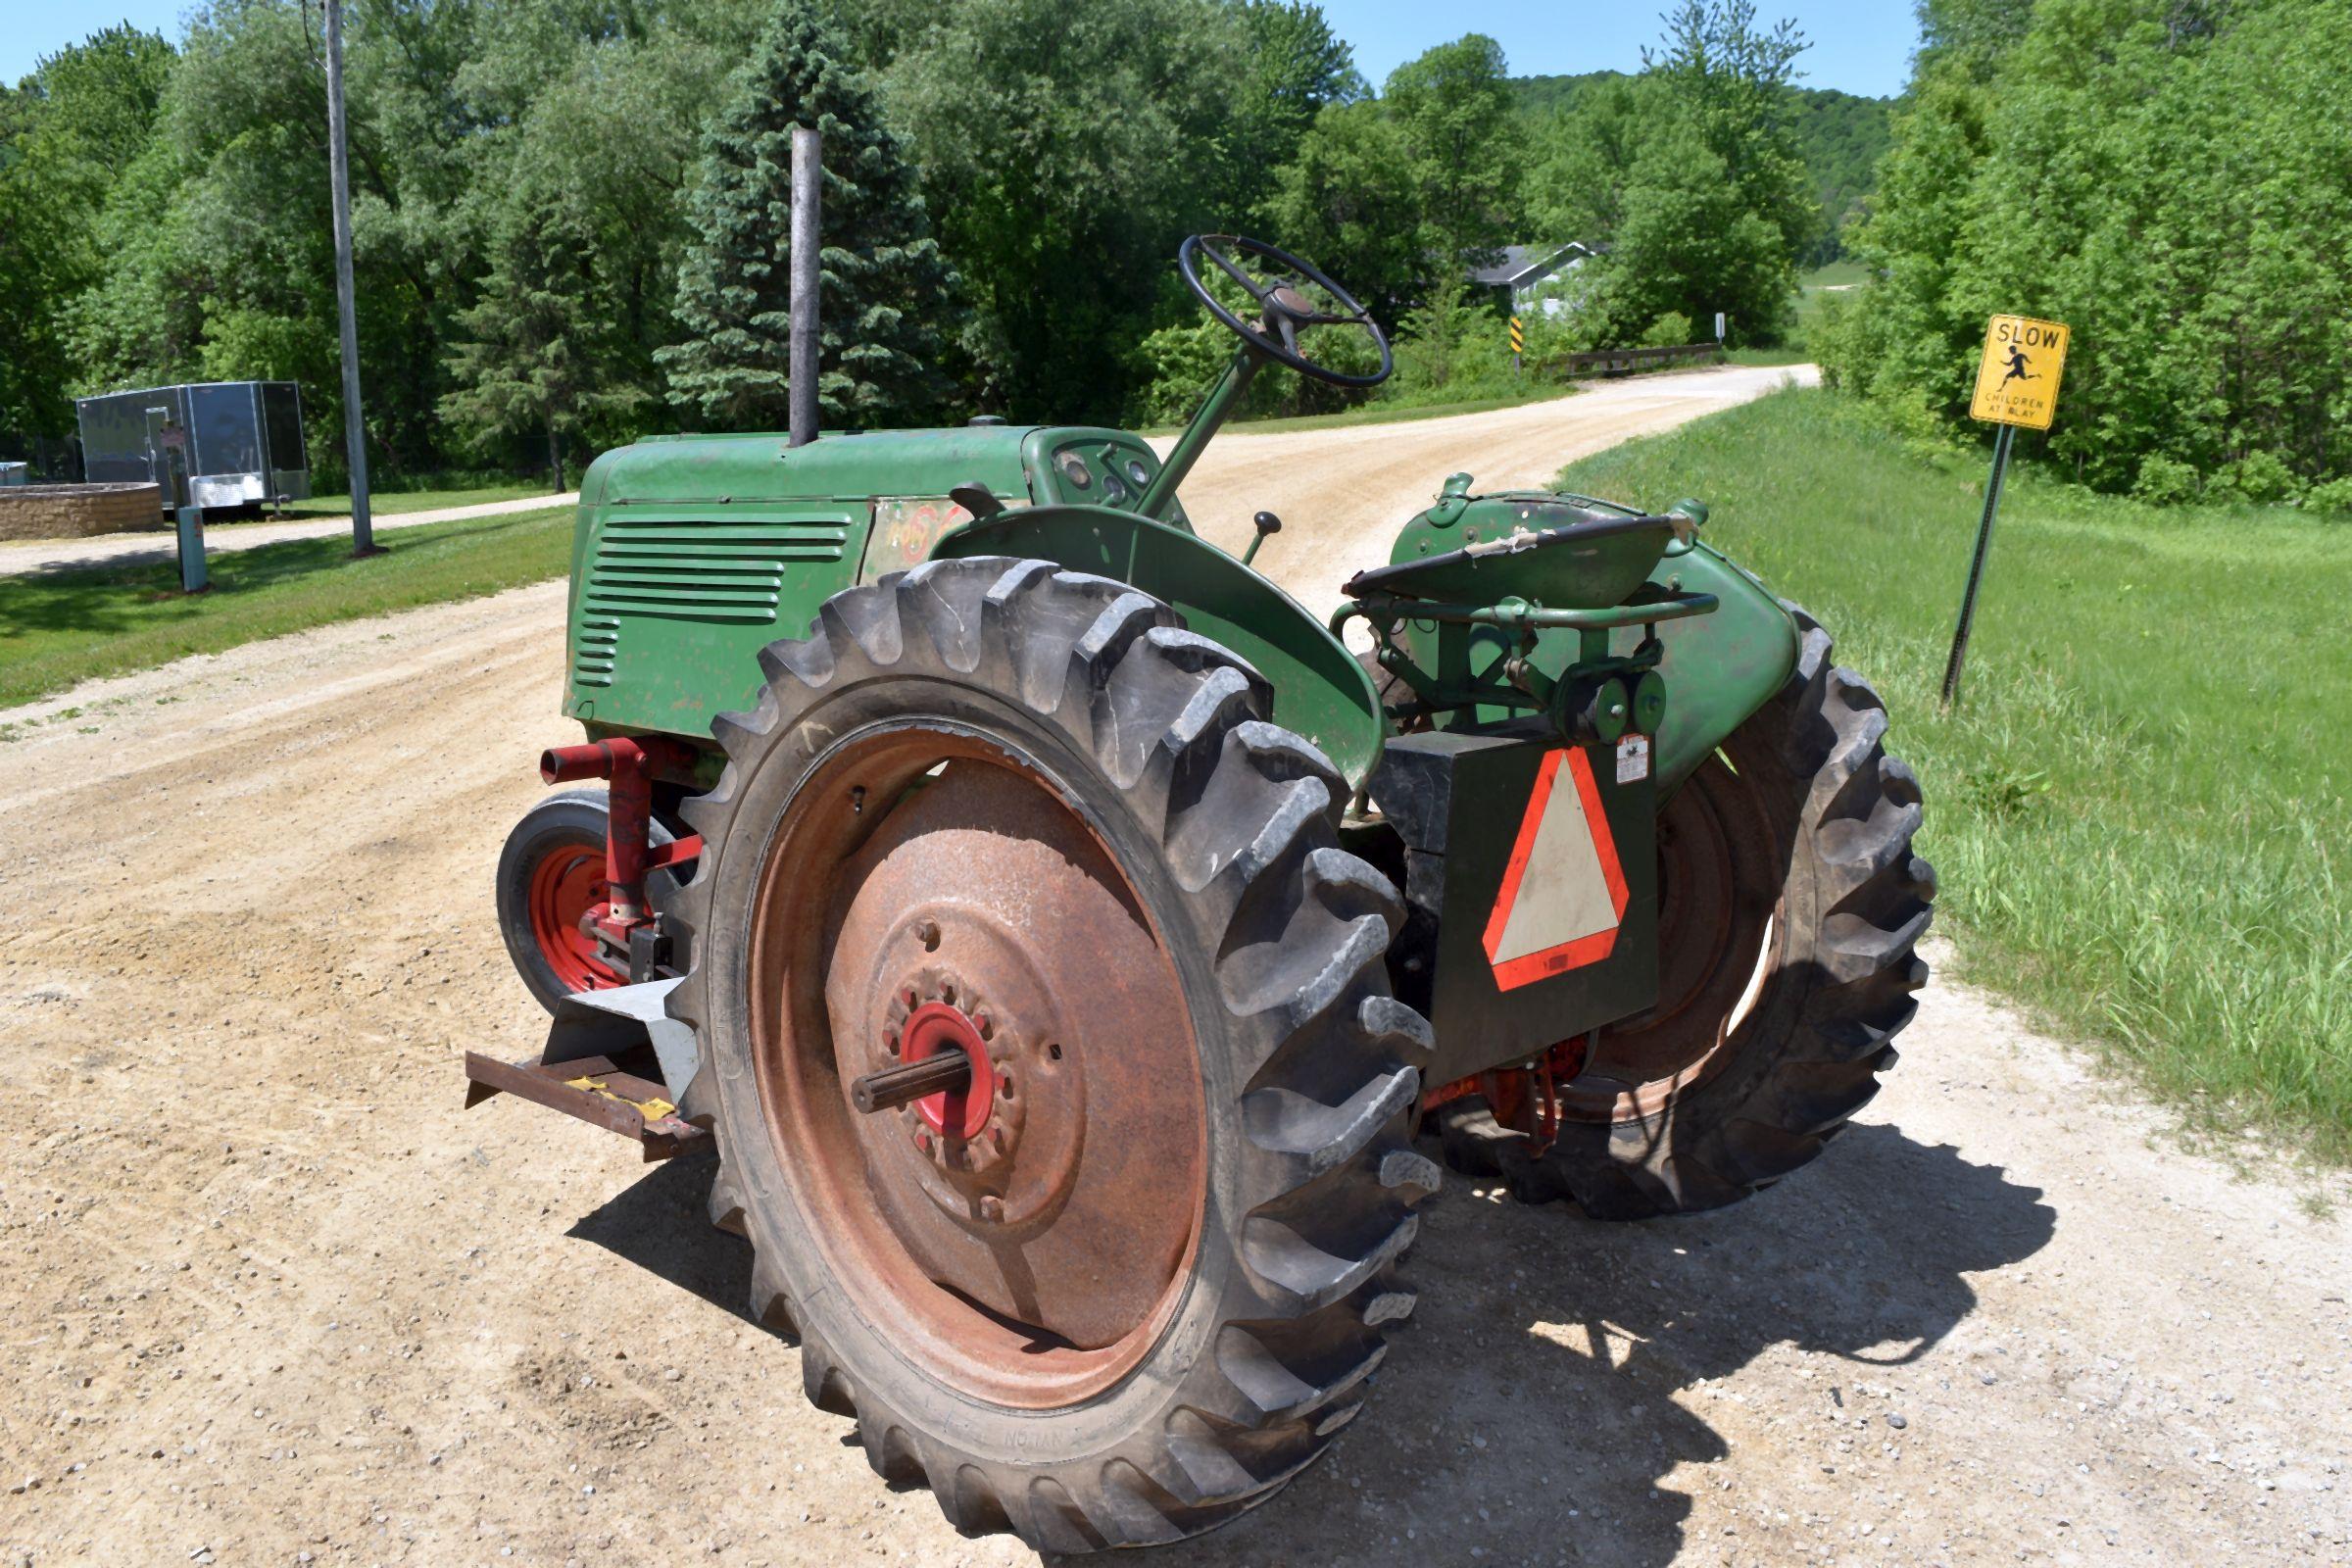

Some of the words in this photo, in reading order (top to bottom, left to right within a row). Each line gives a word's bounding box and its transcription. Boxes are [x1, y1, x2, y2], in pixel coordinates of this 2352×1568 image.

[1997, 323, 2060, 349] SLOW
[1985, 393, 2043, 409] CHILDREN
[1988, 405, 2000, 414] AT
